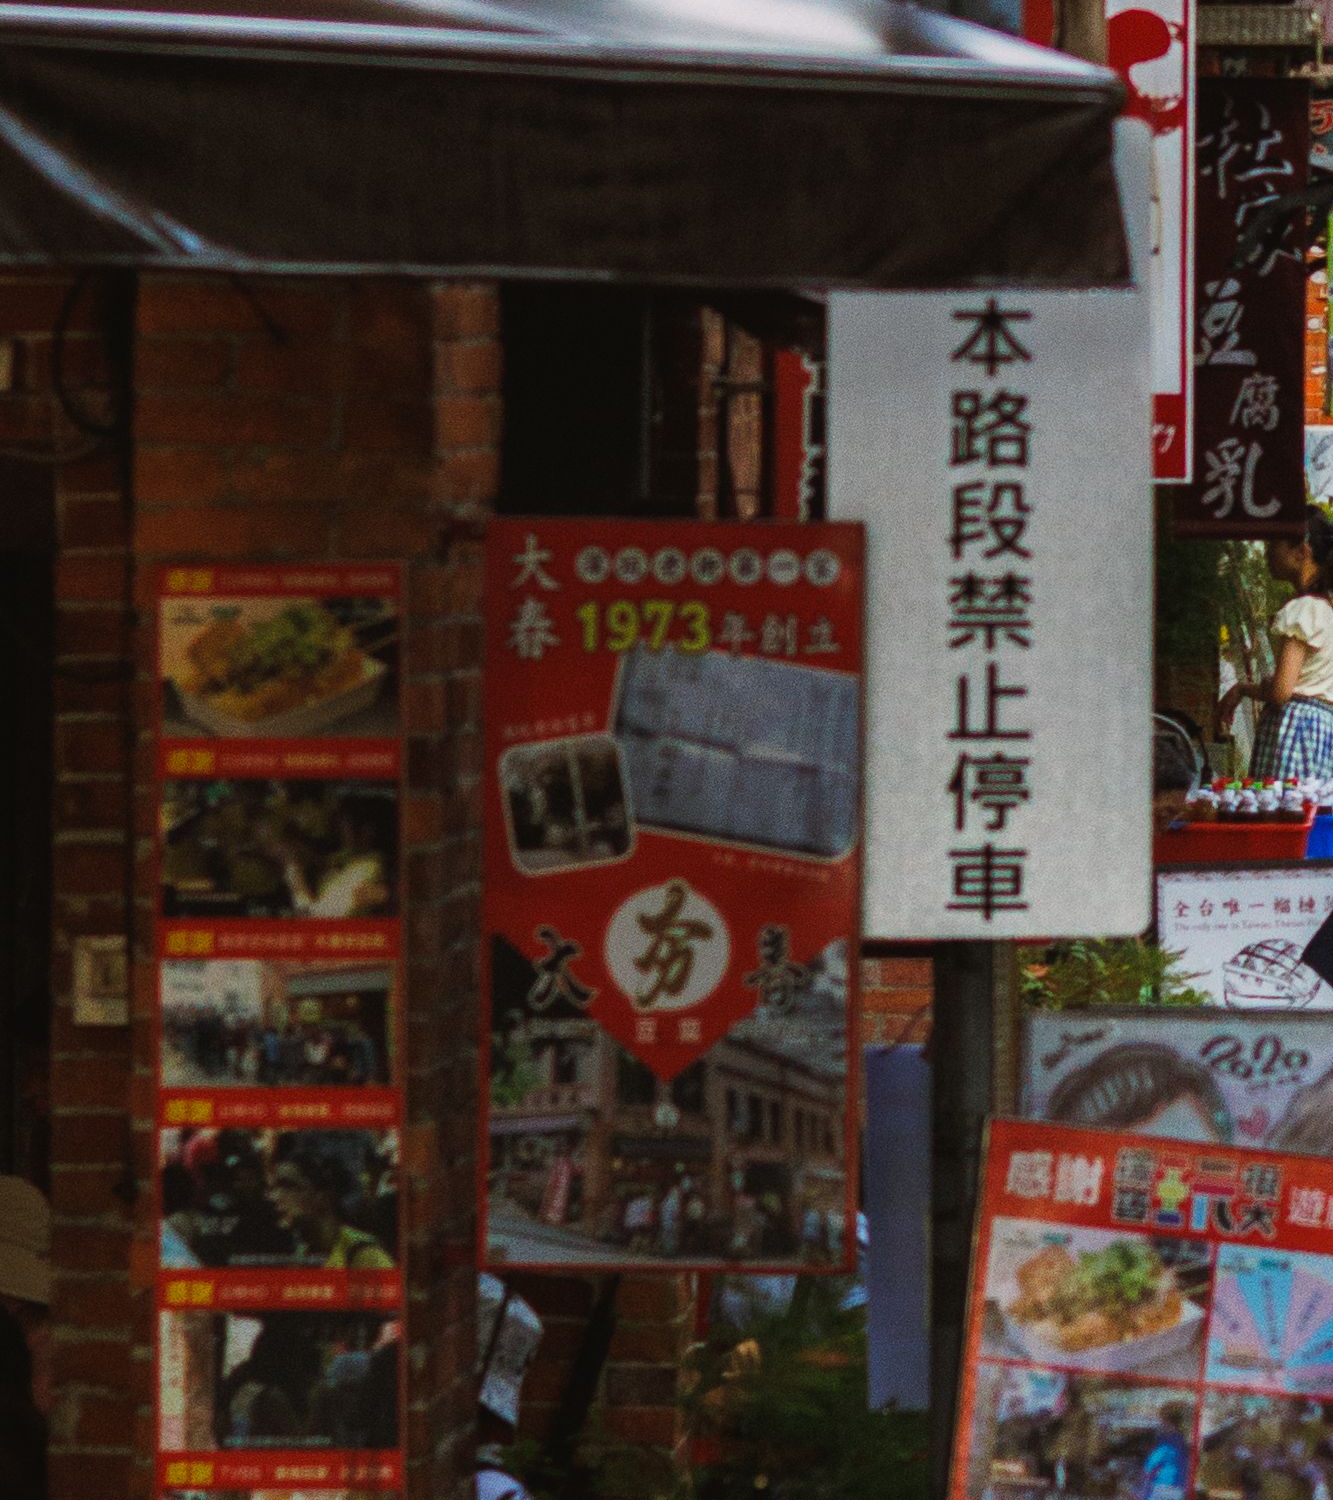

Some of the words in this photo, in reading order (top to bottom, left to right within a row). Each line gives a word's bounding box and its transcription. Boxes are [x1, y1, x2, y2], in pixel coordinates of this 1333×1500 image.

[946, 300, 1032, 922] 本路段禁止停車
